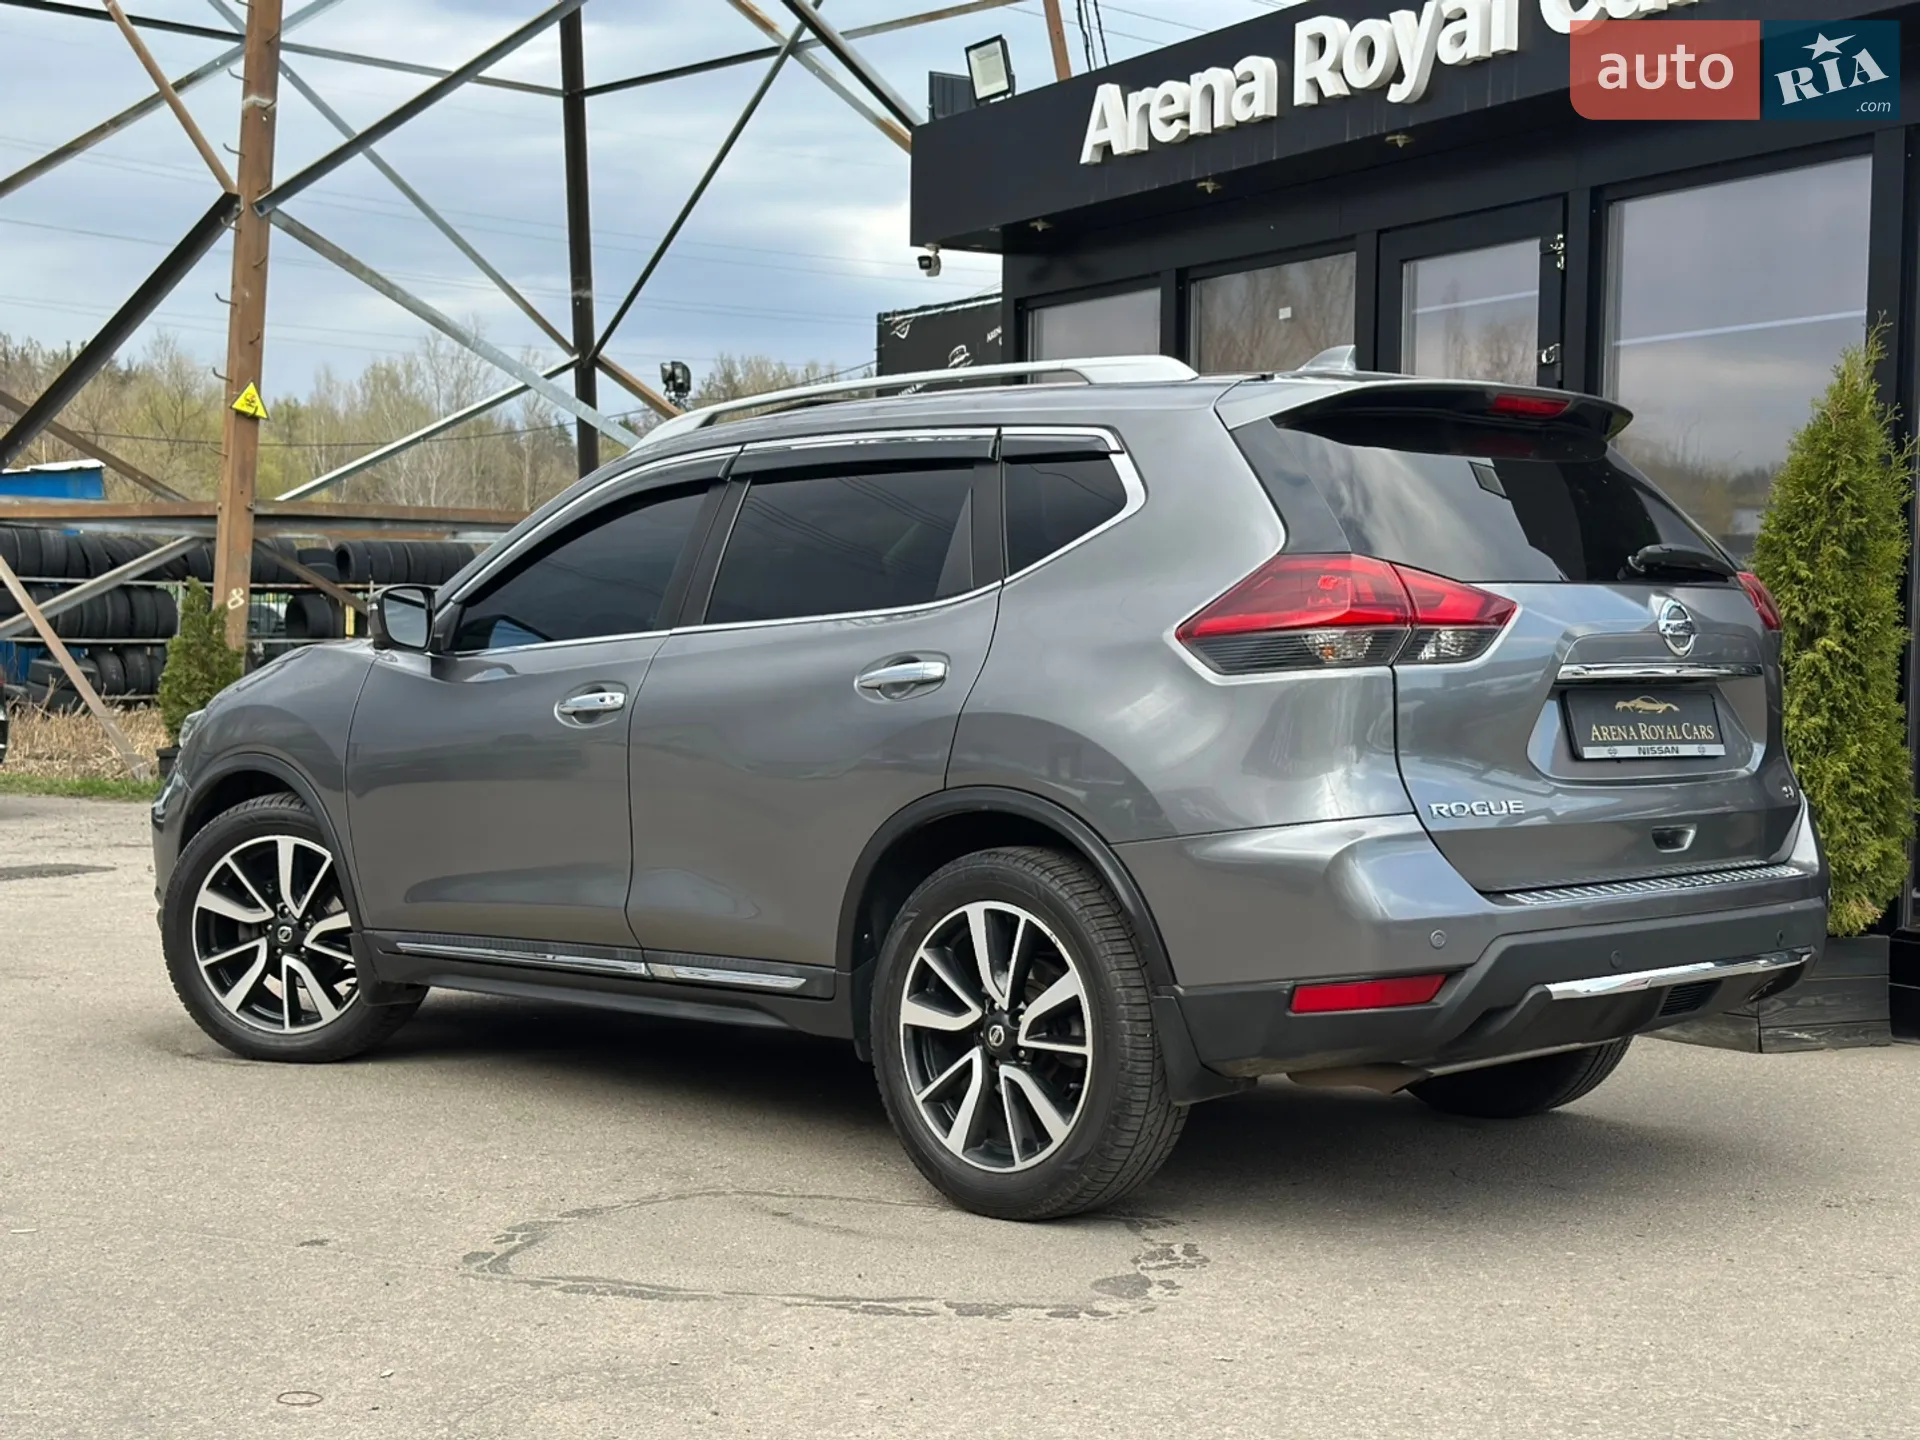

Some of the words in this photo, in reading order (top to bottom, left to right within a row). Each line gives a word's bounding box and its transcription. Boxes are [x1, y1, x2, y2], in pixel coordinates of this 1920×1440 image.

[1080, 55, 1278, 165] Arena
[1294, 0, 1519, 104] Royal
[1591, 724, 1639, 741] ARENA
[1637, 722, 1682, 740] ROYAL
[1681, 722, 1715, 740] CARS
[1637, 746, 1680, 755] NISSAN
[1429, 800, 1526, 819] ROGUE
